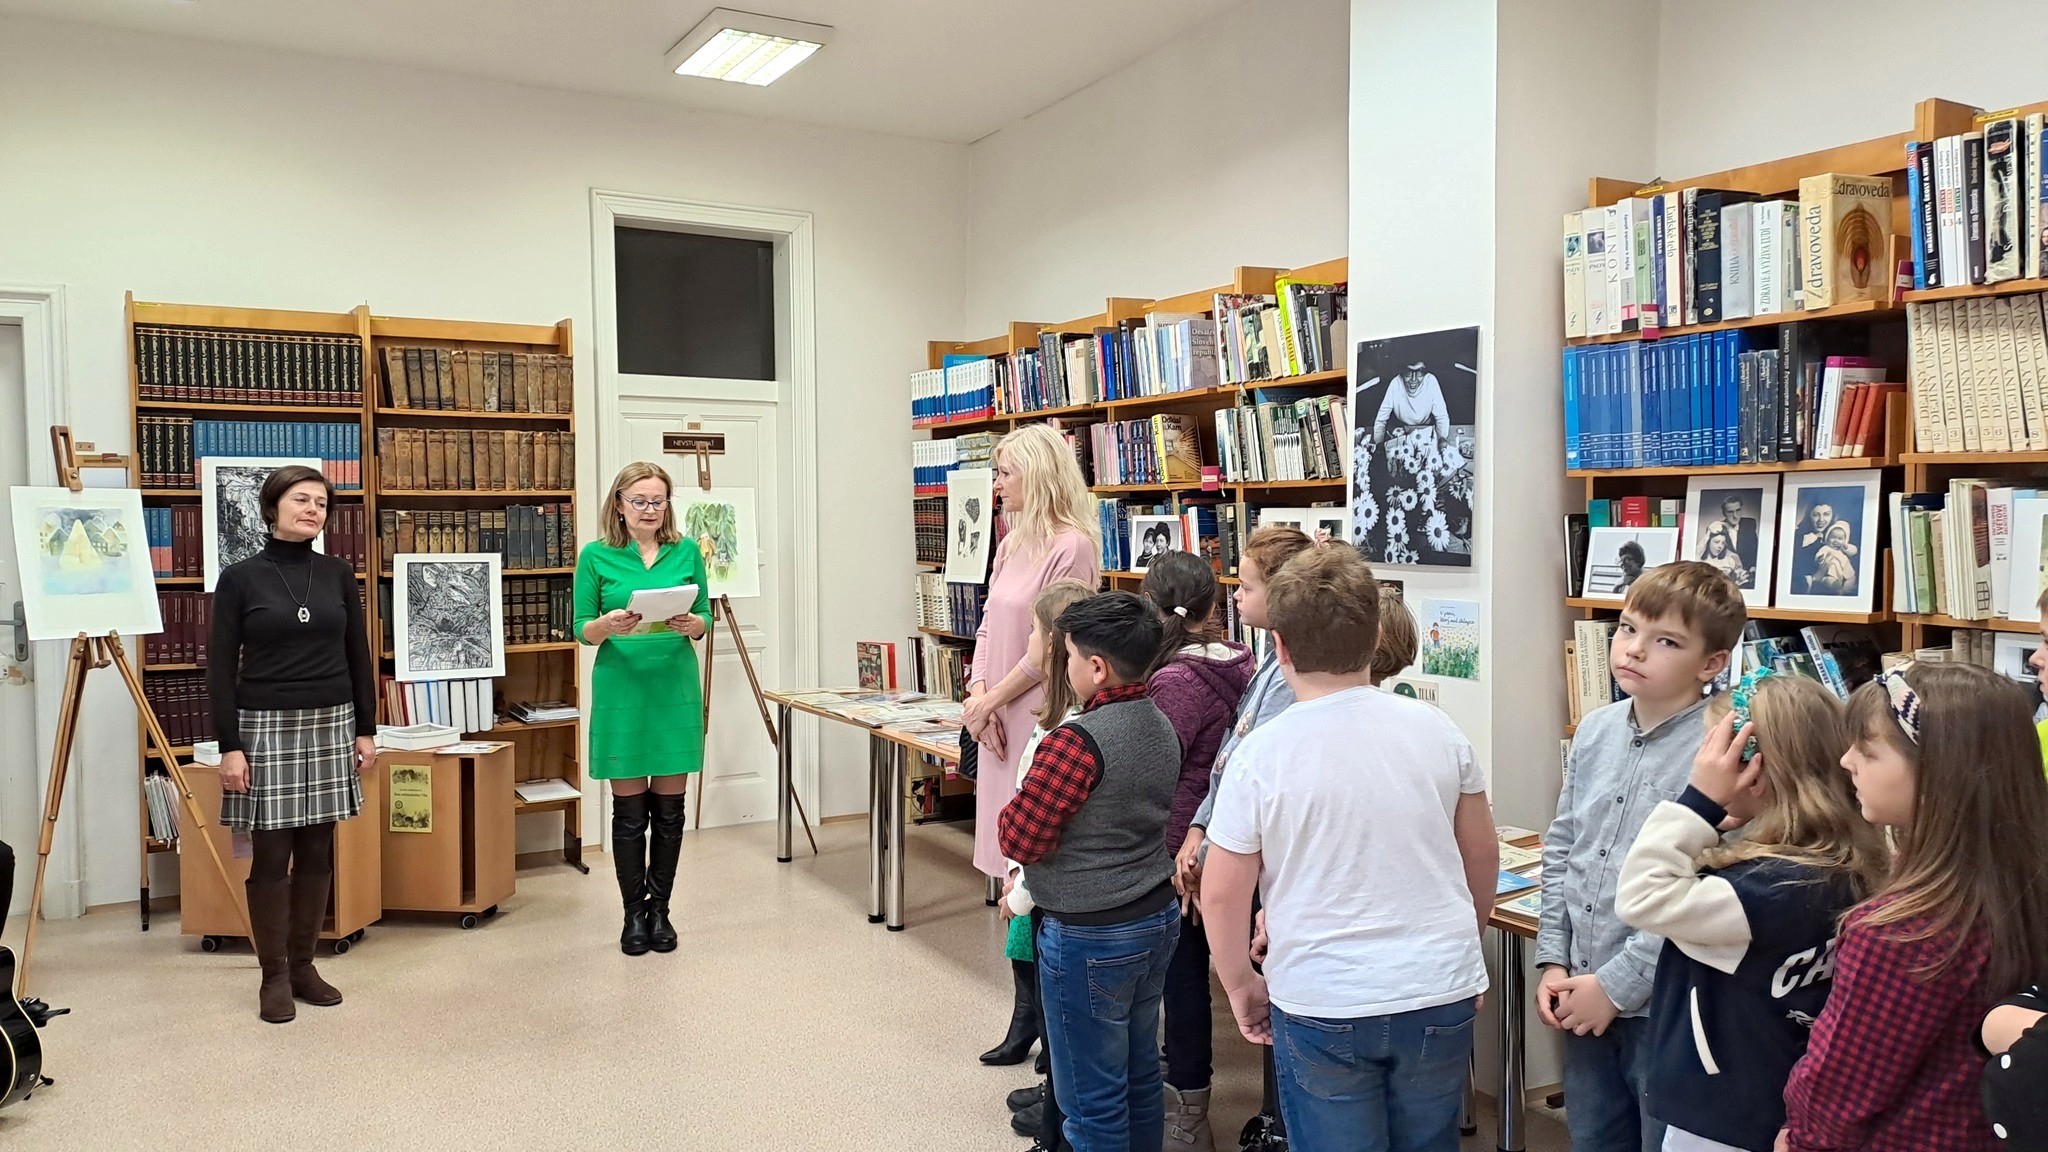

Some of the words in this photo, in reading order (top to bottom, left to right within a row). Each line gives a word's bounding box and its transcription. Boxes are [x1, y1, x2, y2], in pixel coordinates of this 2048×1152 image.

[1833, 177, 1889, 198] Zdravoveda
[1667, 242, 1676, 257] telo
[1806, 205, 1823, 299] Zdravoveda
[1760, 277, 1771, 305] ZDRAVIE
[1285, 327, 1295, 362] moda
[1923, 310, 1935, 369] UMENIA
[1939, 306, 1952, 365] UMENIA
[1956, 303, 1969, 363] UMENIA
[1969, 303, 1983, 363] UMENIA
[1983, 302, 1996, 362] UMENIA
[1998, 313, 2012, 361] UMENI
[2014, 304, 2029, 364] UMENIA
[1927, 374, 1940, 424] DEJINY
[1944, 371, 1957, 421] DEJINY
[1961, 368, 1974, 419] DEJINY
[1976, 368, 1990, 419] DEJINY
[1988, 367, 2002, 418] DEJINY
[2005, 369, 2019, 420] DEJINY
[2022, 370, 2037, 422] DEJINY
